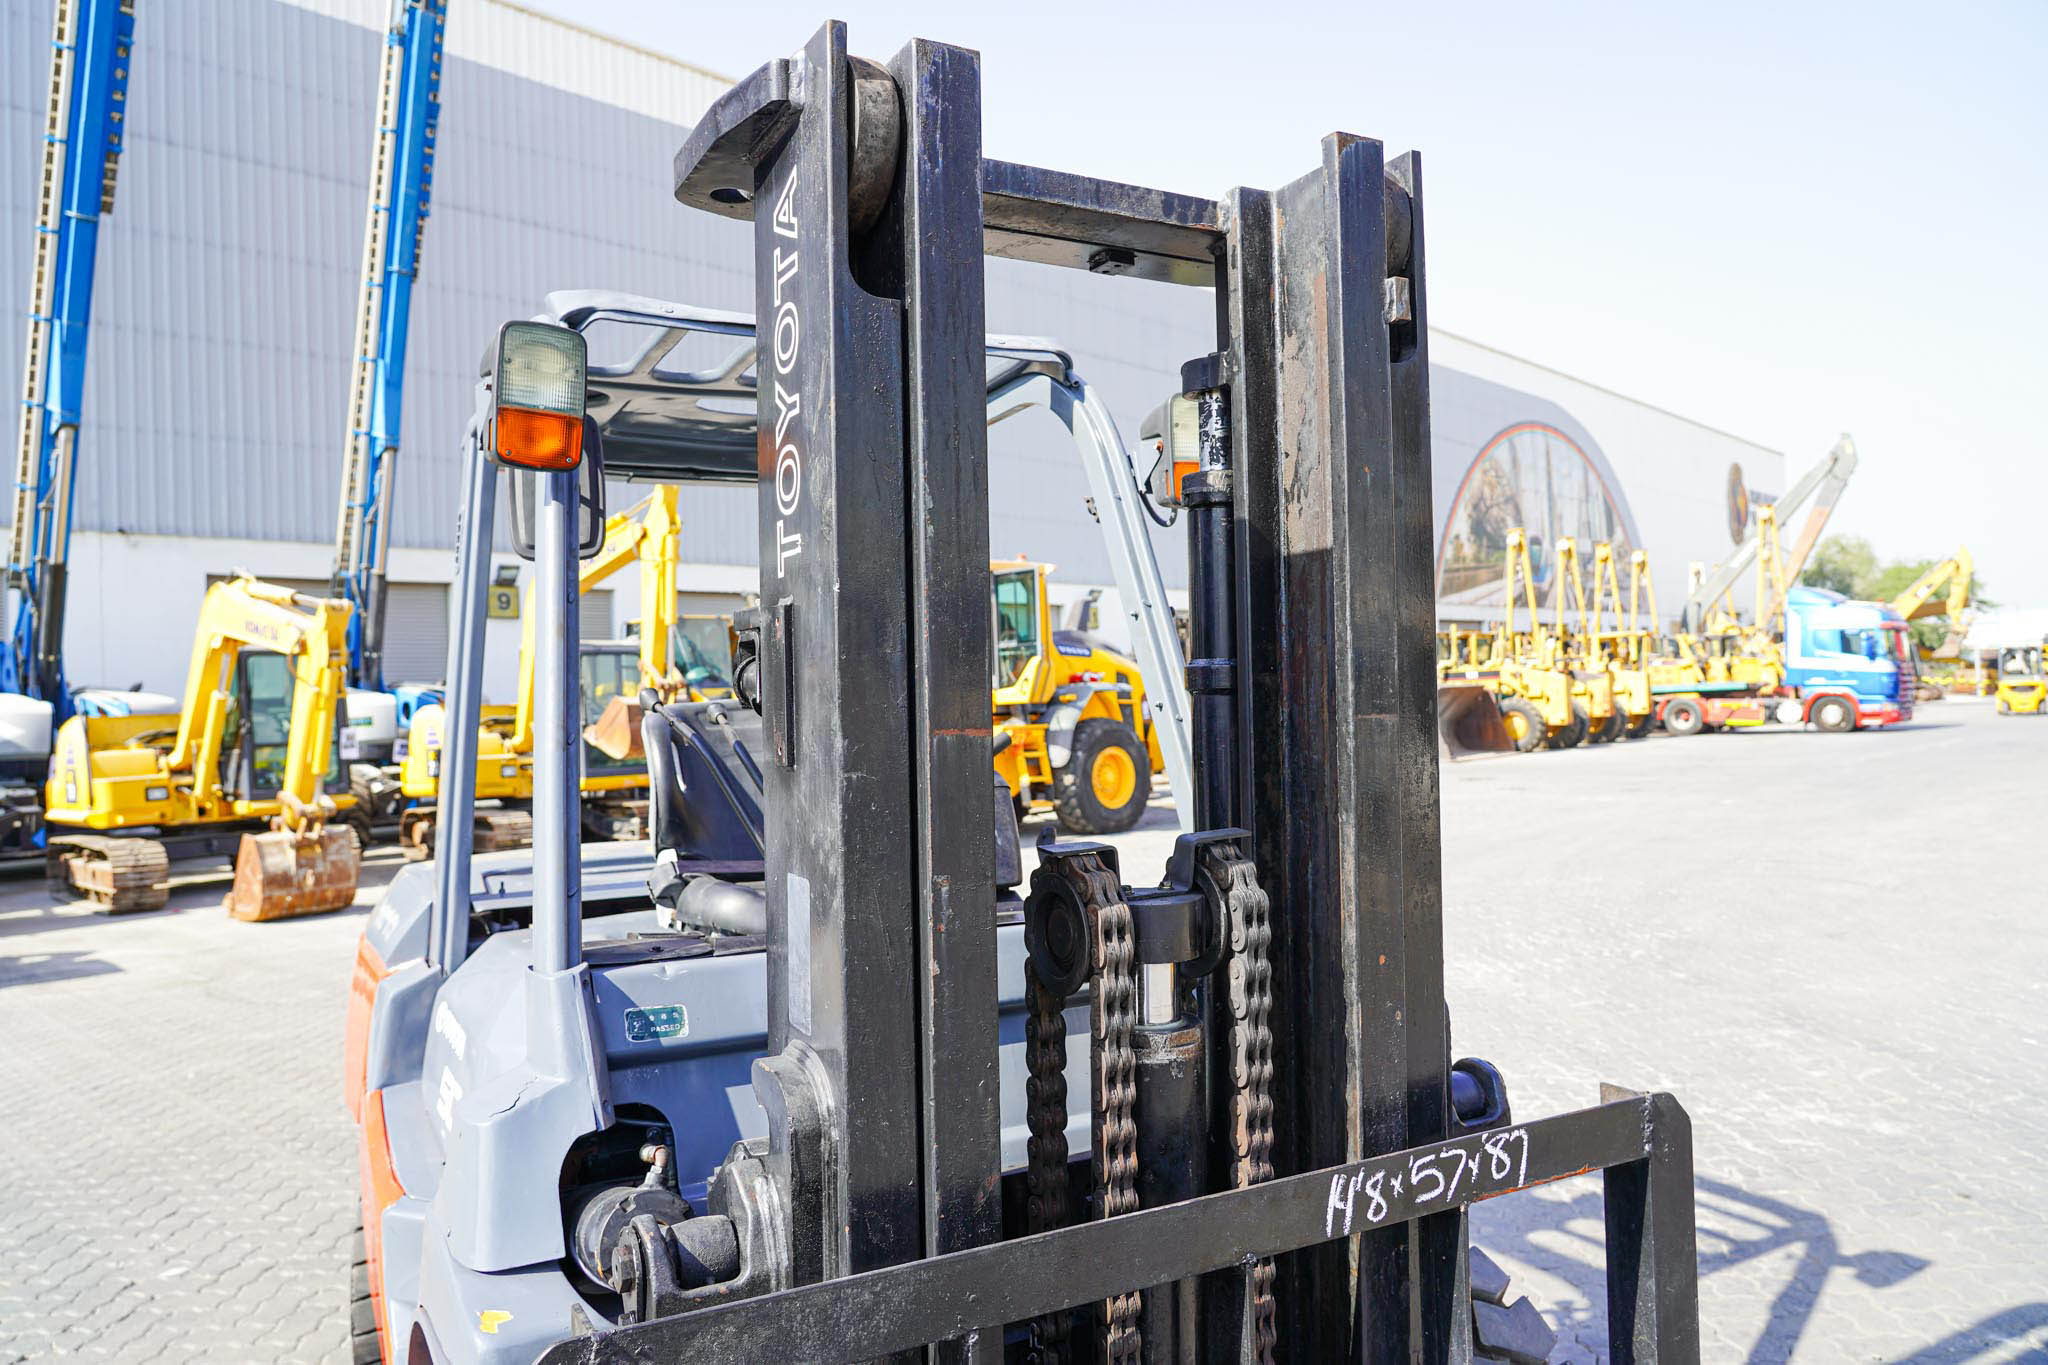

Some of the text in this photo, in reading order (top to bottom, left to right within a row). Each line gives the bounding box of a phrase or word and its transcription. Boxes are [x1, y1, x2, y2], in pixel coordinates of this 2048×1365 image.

[773, 163, 801, 579] TOYOTA
[497, 592, 511, 610] 9
[650, 1023, 681, 1033] PASSED
